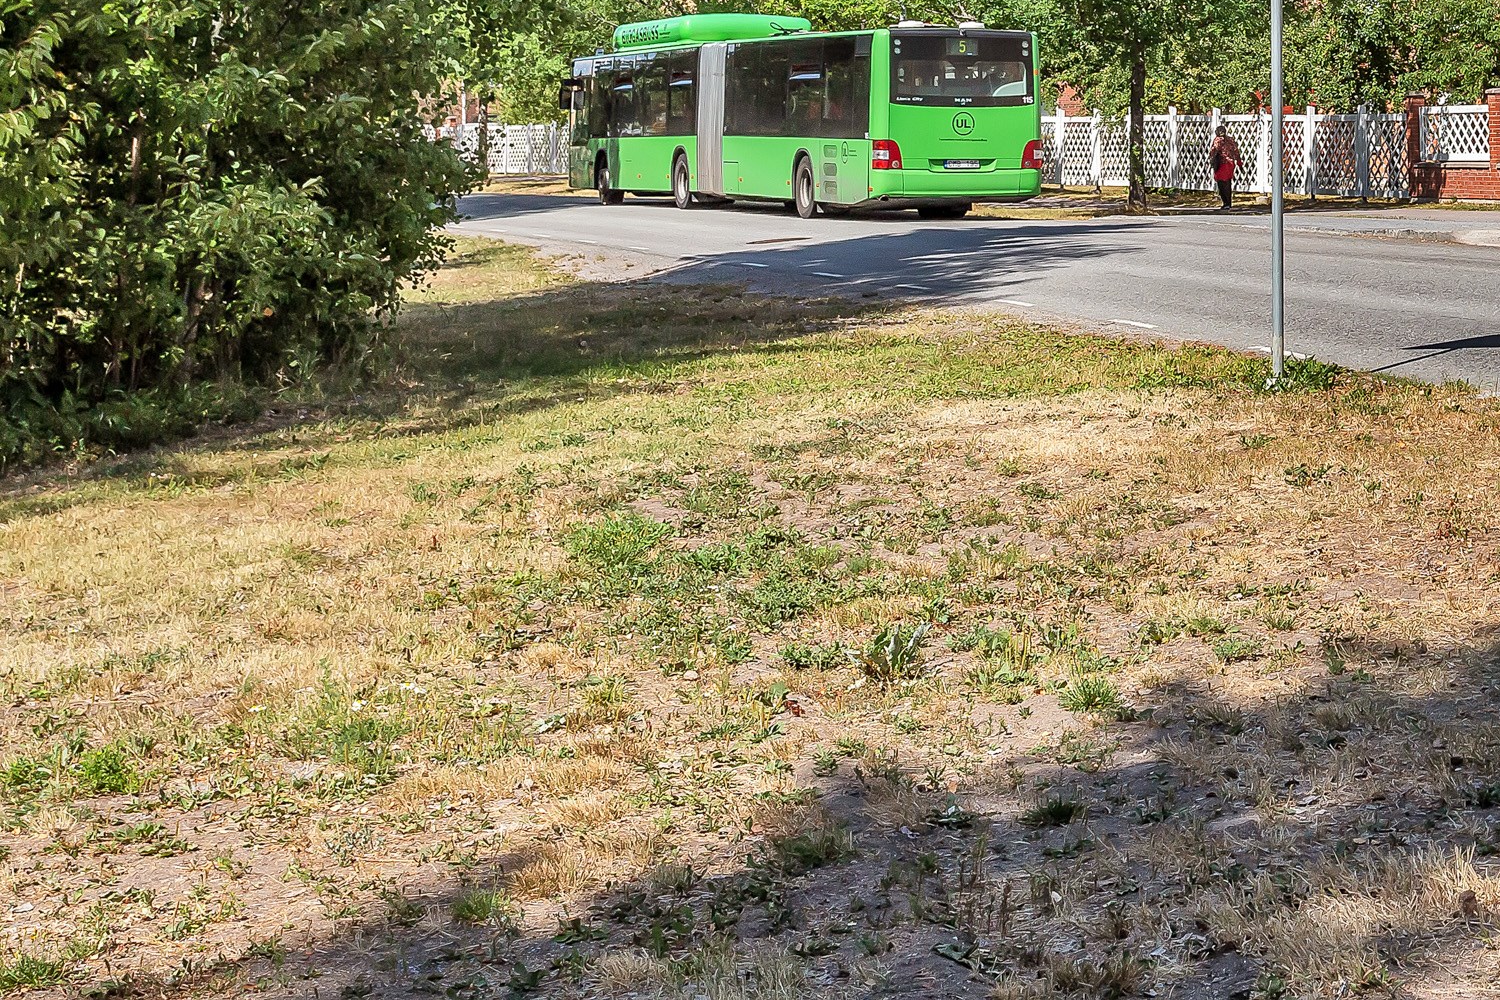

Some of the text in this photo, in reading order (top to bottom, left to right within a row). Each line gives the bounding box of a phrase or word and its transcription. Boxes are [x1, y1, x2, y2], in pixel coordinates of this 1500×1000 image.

[959, 40, 966, 53] 5
[1022, 96, 1034, 104] 115
[956, 119, 971, 128] UL
